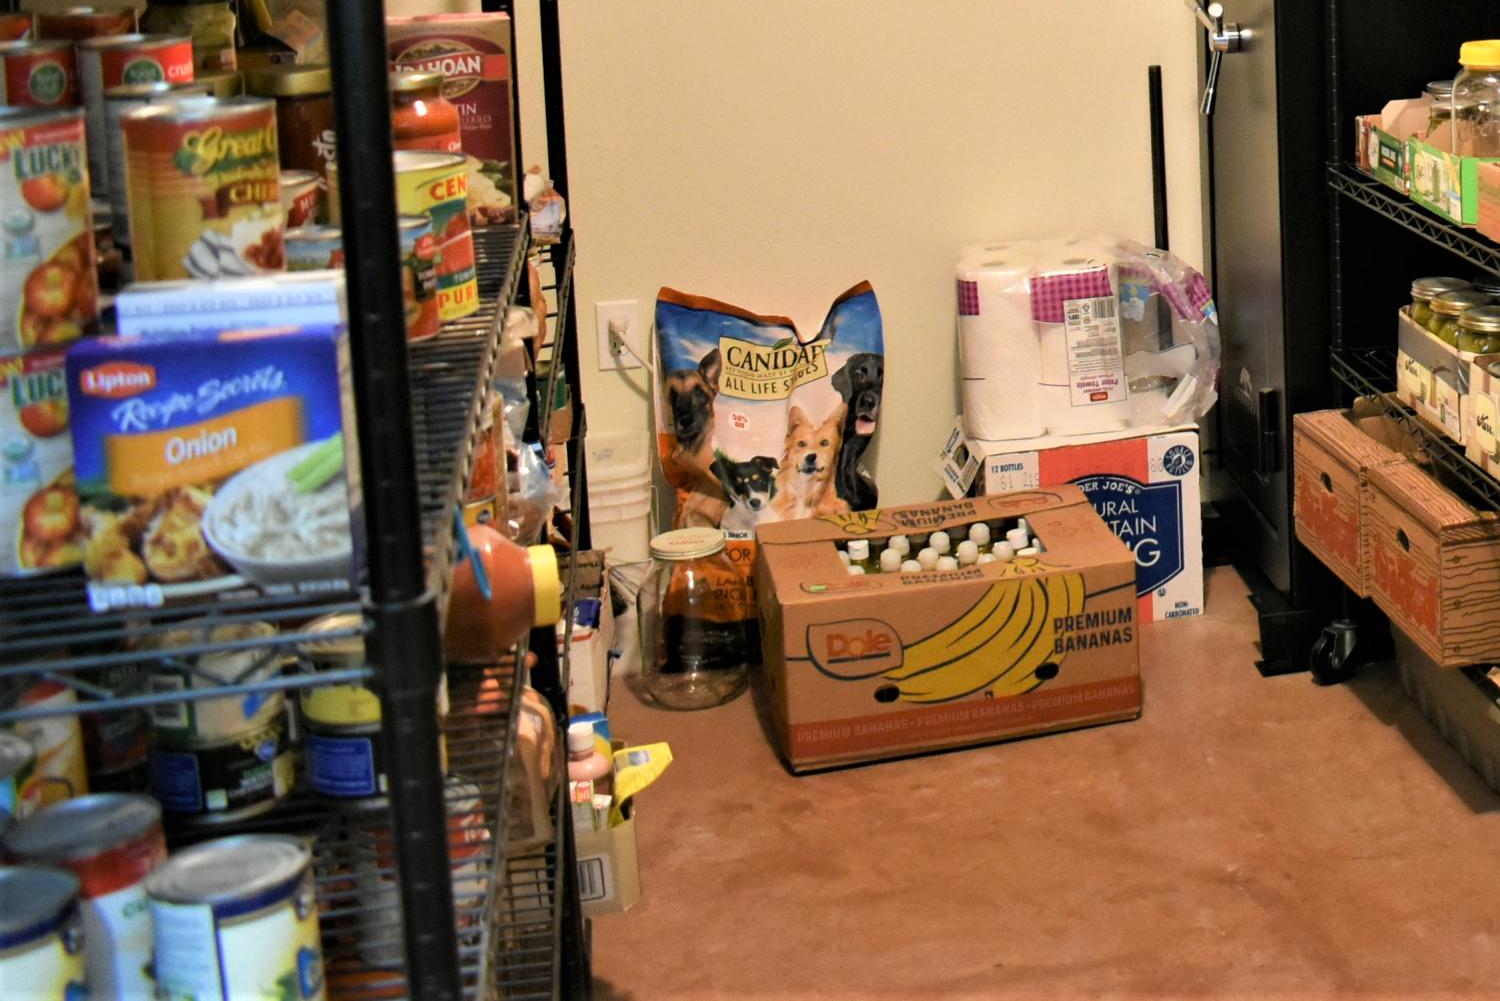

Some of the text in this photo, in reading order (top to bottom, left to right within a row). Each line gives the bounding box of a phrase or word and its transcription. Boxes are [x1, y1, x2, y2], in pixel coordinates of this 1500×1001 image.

[86, 369, 151, 392] Lipton
[725, 376, 745, 392] ALL
[751, 381, 777, 394] LIFE
[111, 365, 286, 433] Recipe Secrets
[164, 426, 238, 467] Onion
[991, 463, 1024, 474] 12 BOTTLES
[1102, 480, 1135, 494] JOE'S
[1054, 607, 1133, 635] PREMIUM
[825, 629, 892, 659] Dole
[1054, 626, 1133, 655] BANANAS
[917, 708, 968, 727] PREMIUM
